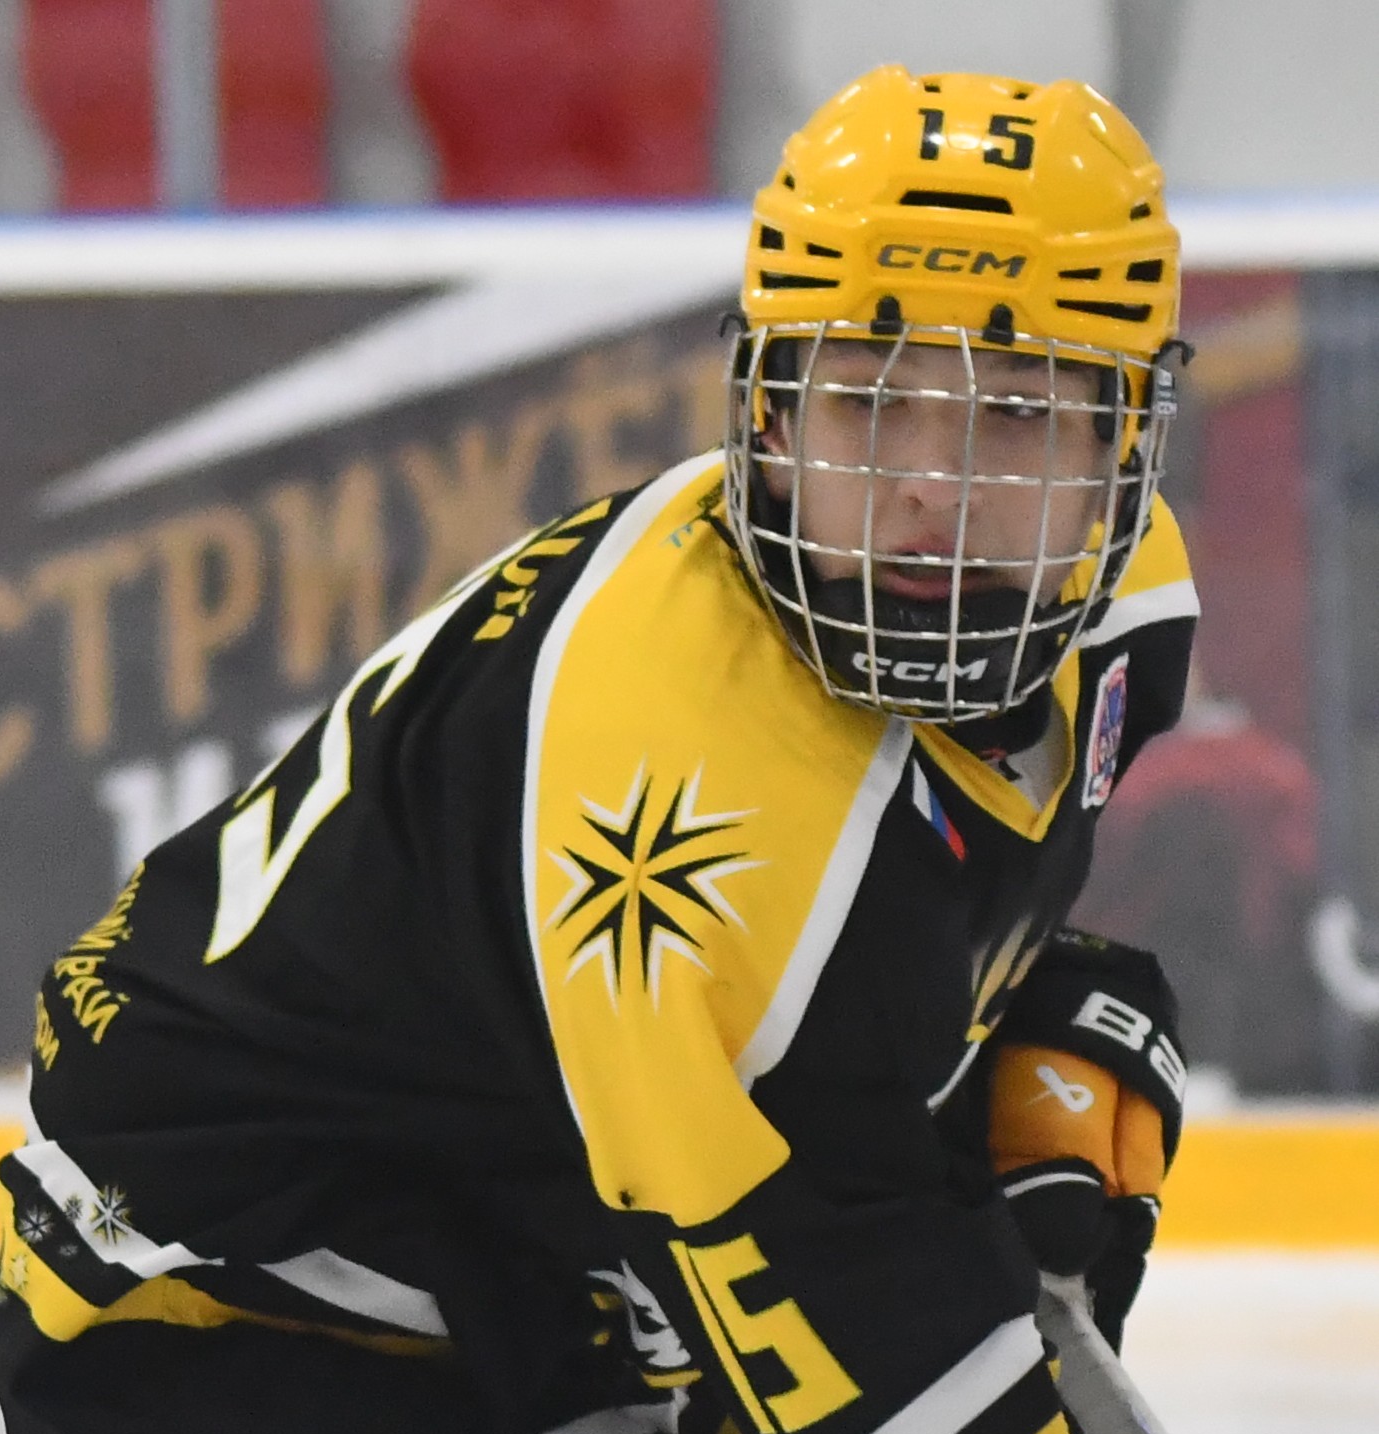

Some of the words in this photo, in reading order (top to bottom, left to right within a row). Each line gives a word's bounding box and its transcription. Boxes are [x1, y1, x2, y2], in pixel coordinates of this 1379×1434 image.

[917, 107, 1038, 171] 15
[877, 243, 1027, 278] CCM
[851, 651, 990, 682] CCM
